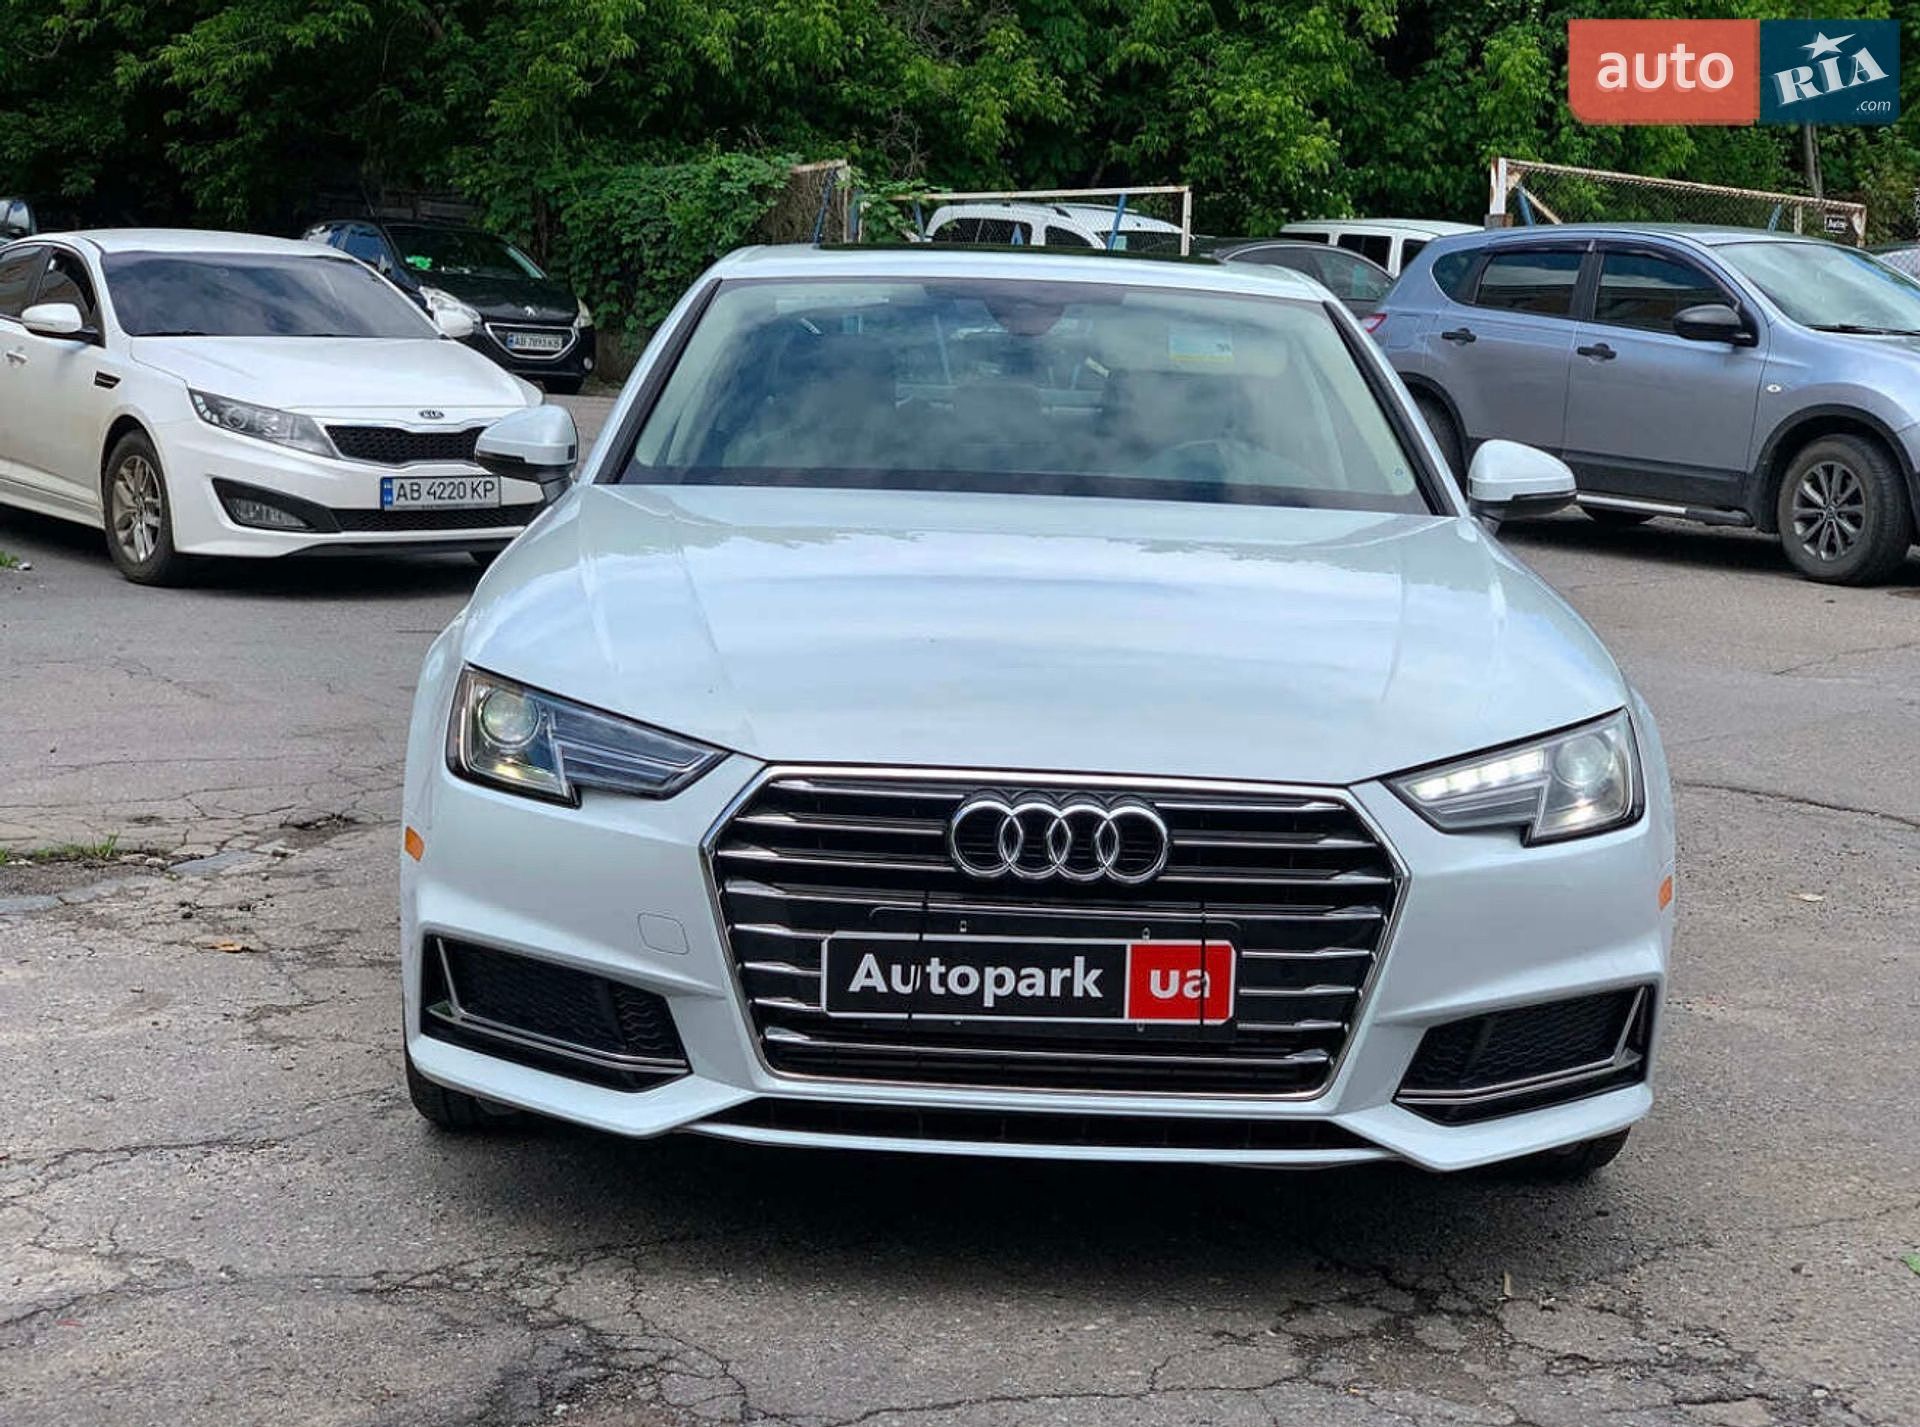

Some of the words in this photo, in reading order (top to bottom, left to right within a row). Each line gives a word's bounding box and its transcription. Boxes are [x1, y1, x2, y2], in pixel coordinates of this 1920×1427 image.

[396, 482, 422, 501] AB
[427, 481, 467, 500] 4220
[471, 480, 495, 499] KP
[848, 953, 1104, 1008] Autopark
[1149, 968, 1211, 999] ua
